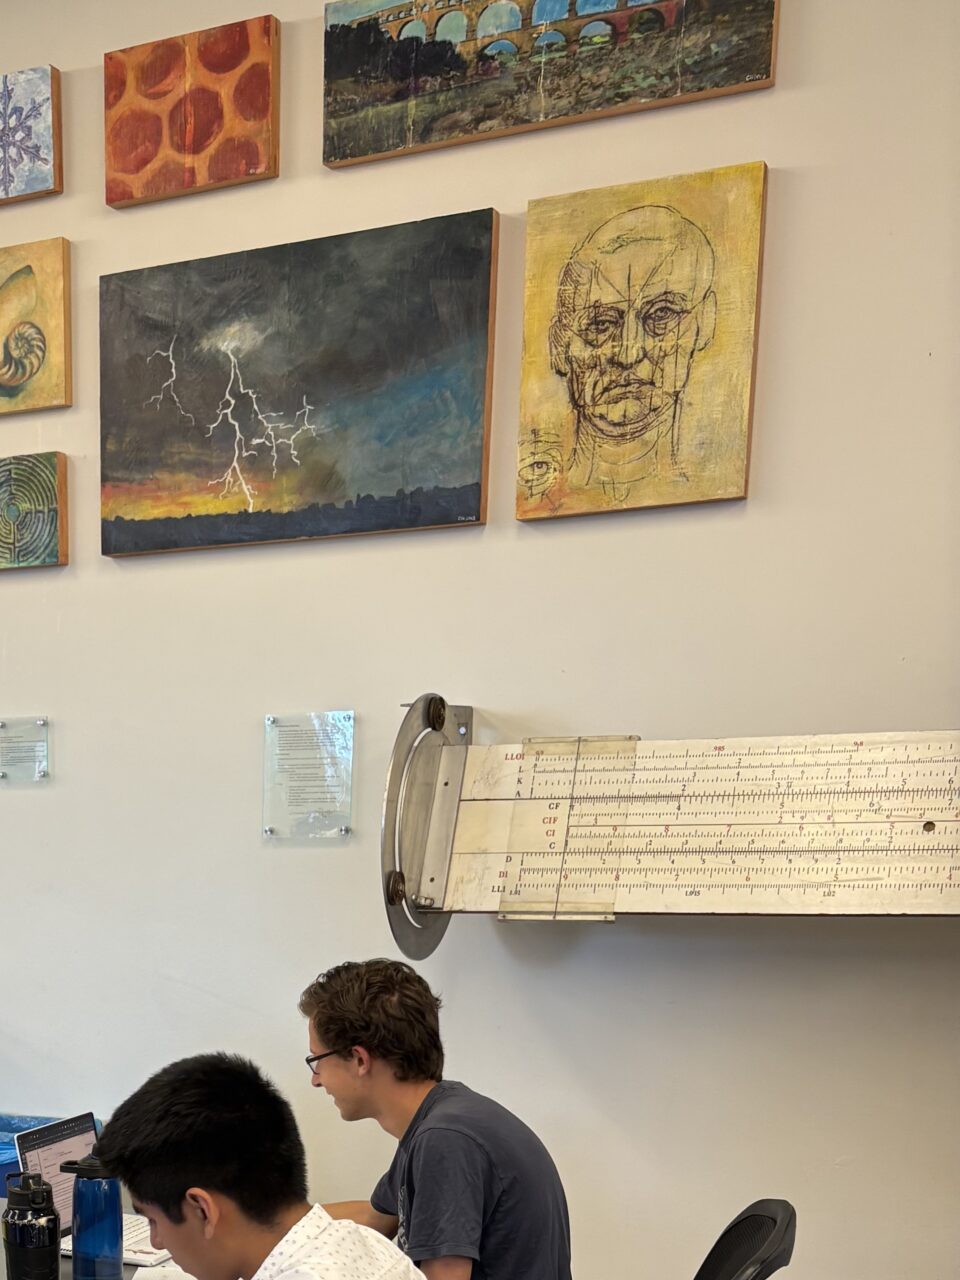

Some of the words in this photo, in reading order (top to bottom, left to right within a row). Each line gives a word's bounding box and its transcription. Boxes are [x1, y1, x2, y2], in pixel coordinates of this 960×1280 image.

[517, 777, 522, 785] K
[948, 777, 954, 785] 6
[542, 817, 558, 825] CIF
[545, 829, 556, 837] CI
[505, 855, 512, 863] D
